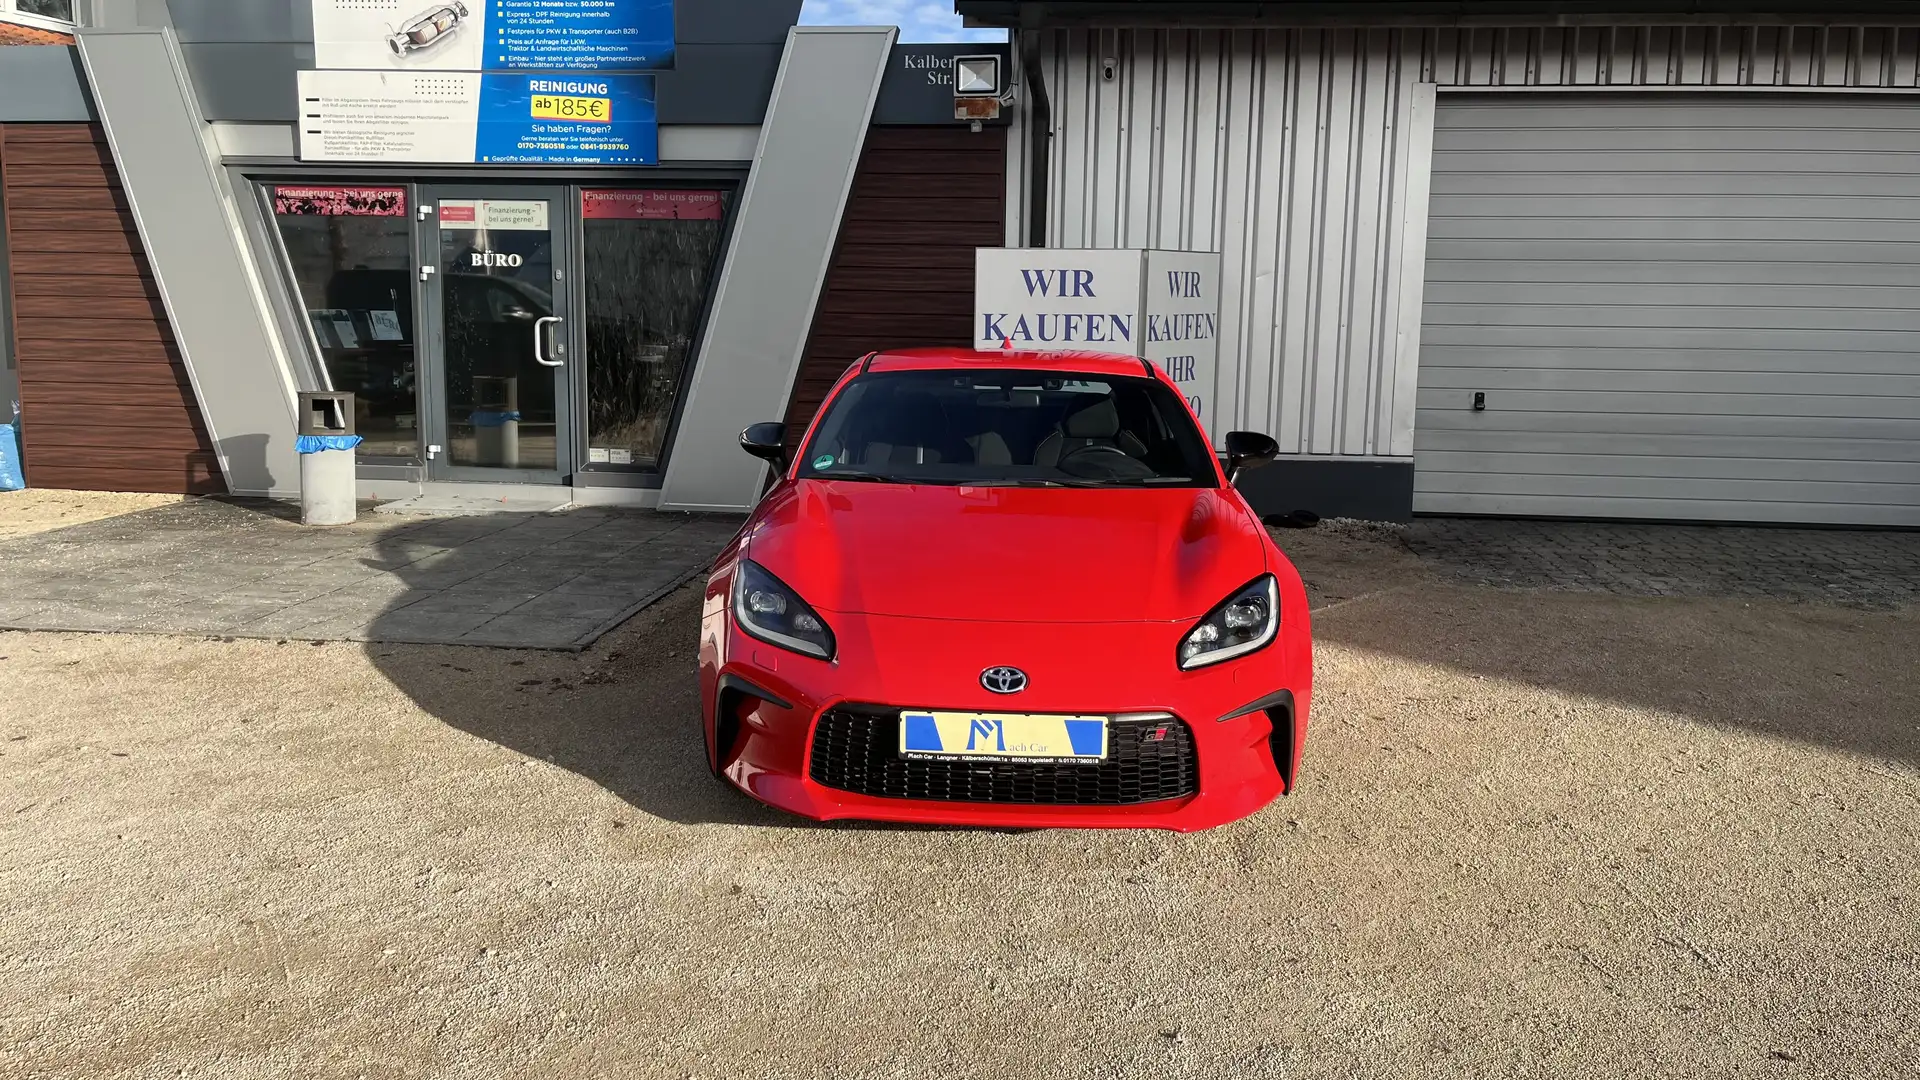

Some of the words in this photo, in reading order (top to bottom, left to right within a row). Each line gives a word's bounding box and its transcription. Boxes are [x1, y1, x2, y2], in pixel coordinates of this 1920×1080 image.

[927, 71, 952, 84] Str.
[530, 80, 608, 94] REINIGUNG
[535, 98, 551, 108] ab
[554, 98, 603, 117] 185€
[548, 125, 574, 133] haben
[576, 125, 612, 134] Fragen?
[278, 189, 334, 198] Finanzierung
[344, 189, 357, 198] bei
[586, 192, 643, 202] Finanzierung
[488, 207, 530, 215] Finanzierung
[471, 250, 522, 267] BÜRO
[1020, 269, 1096, 298] WIR
[1168, 271, 1201, 298] WIR
[982, 313, 1133, 342] KAUFEN
[1147, 313, 1216, 342] KAUFEN
[1166, 356, 1195, 382] IHR
[1030, 743, 1048, 752] Car
